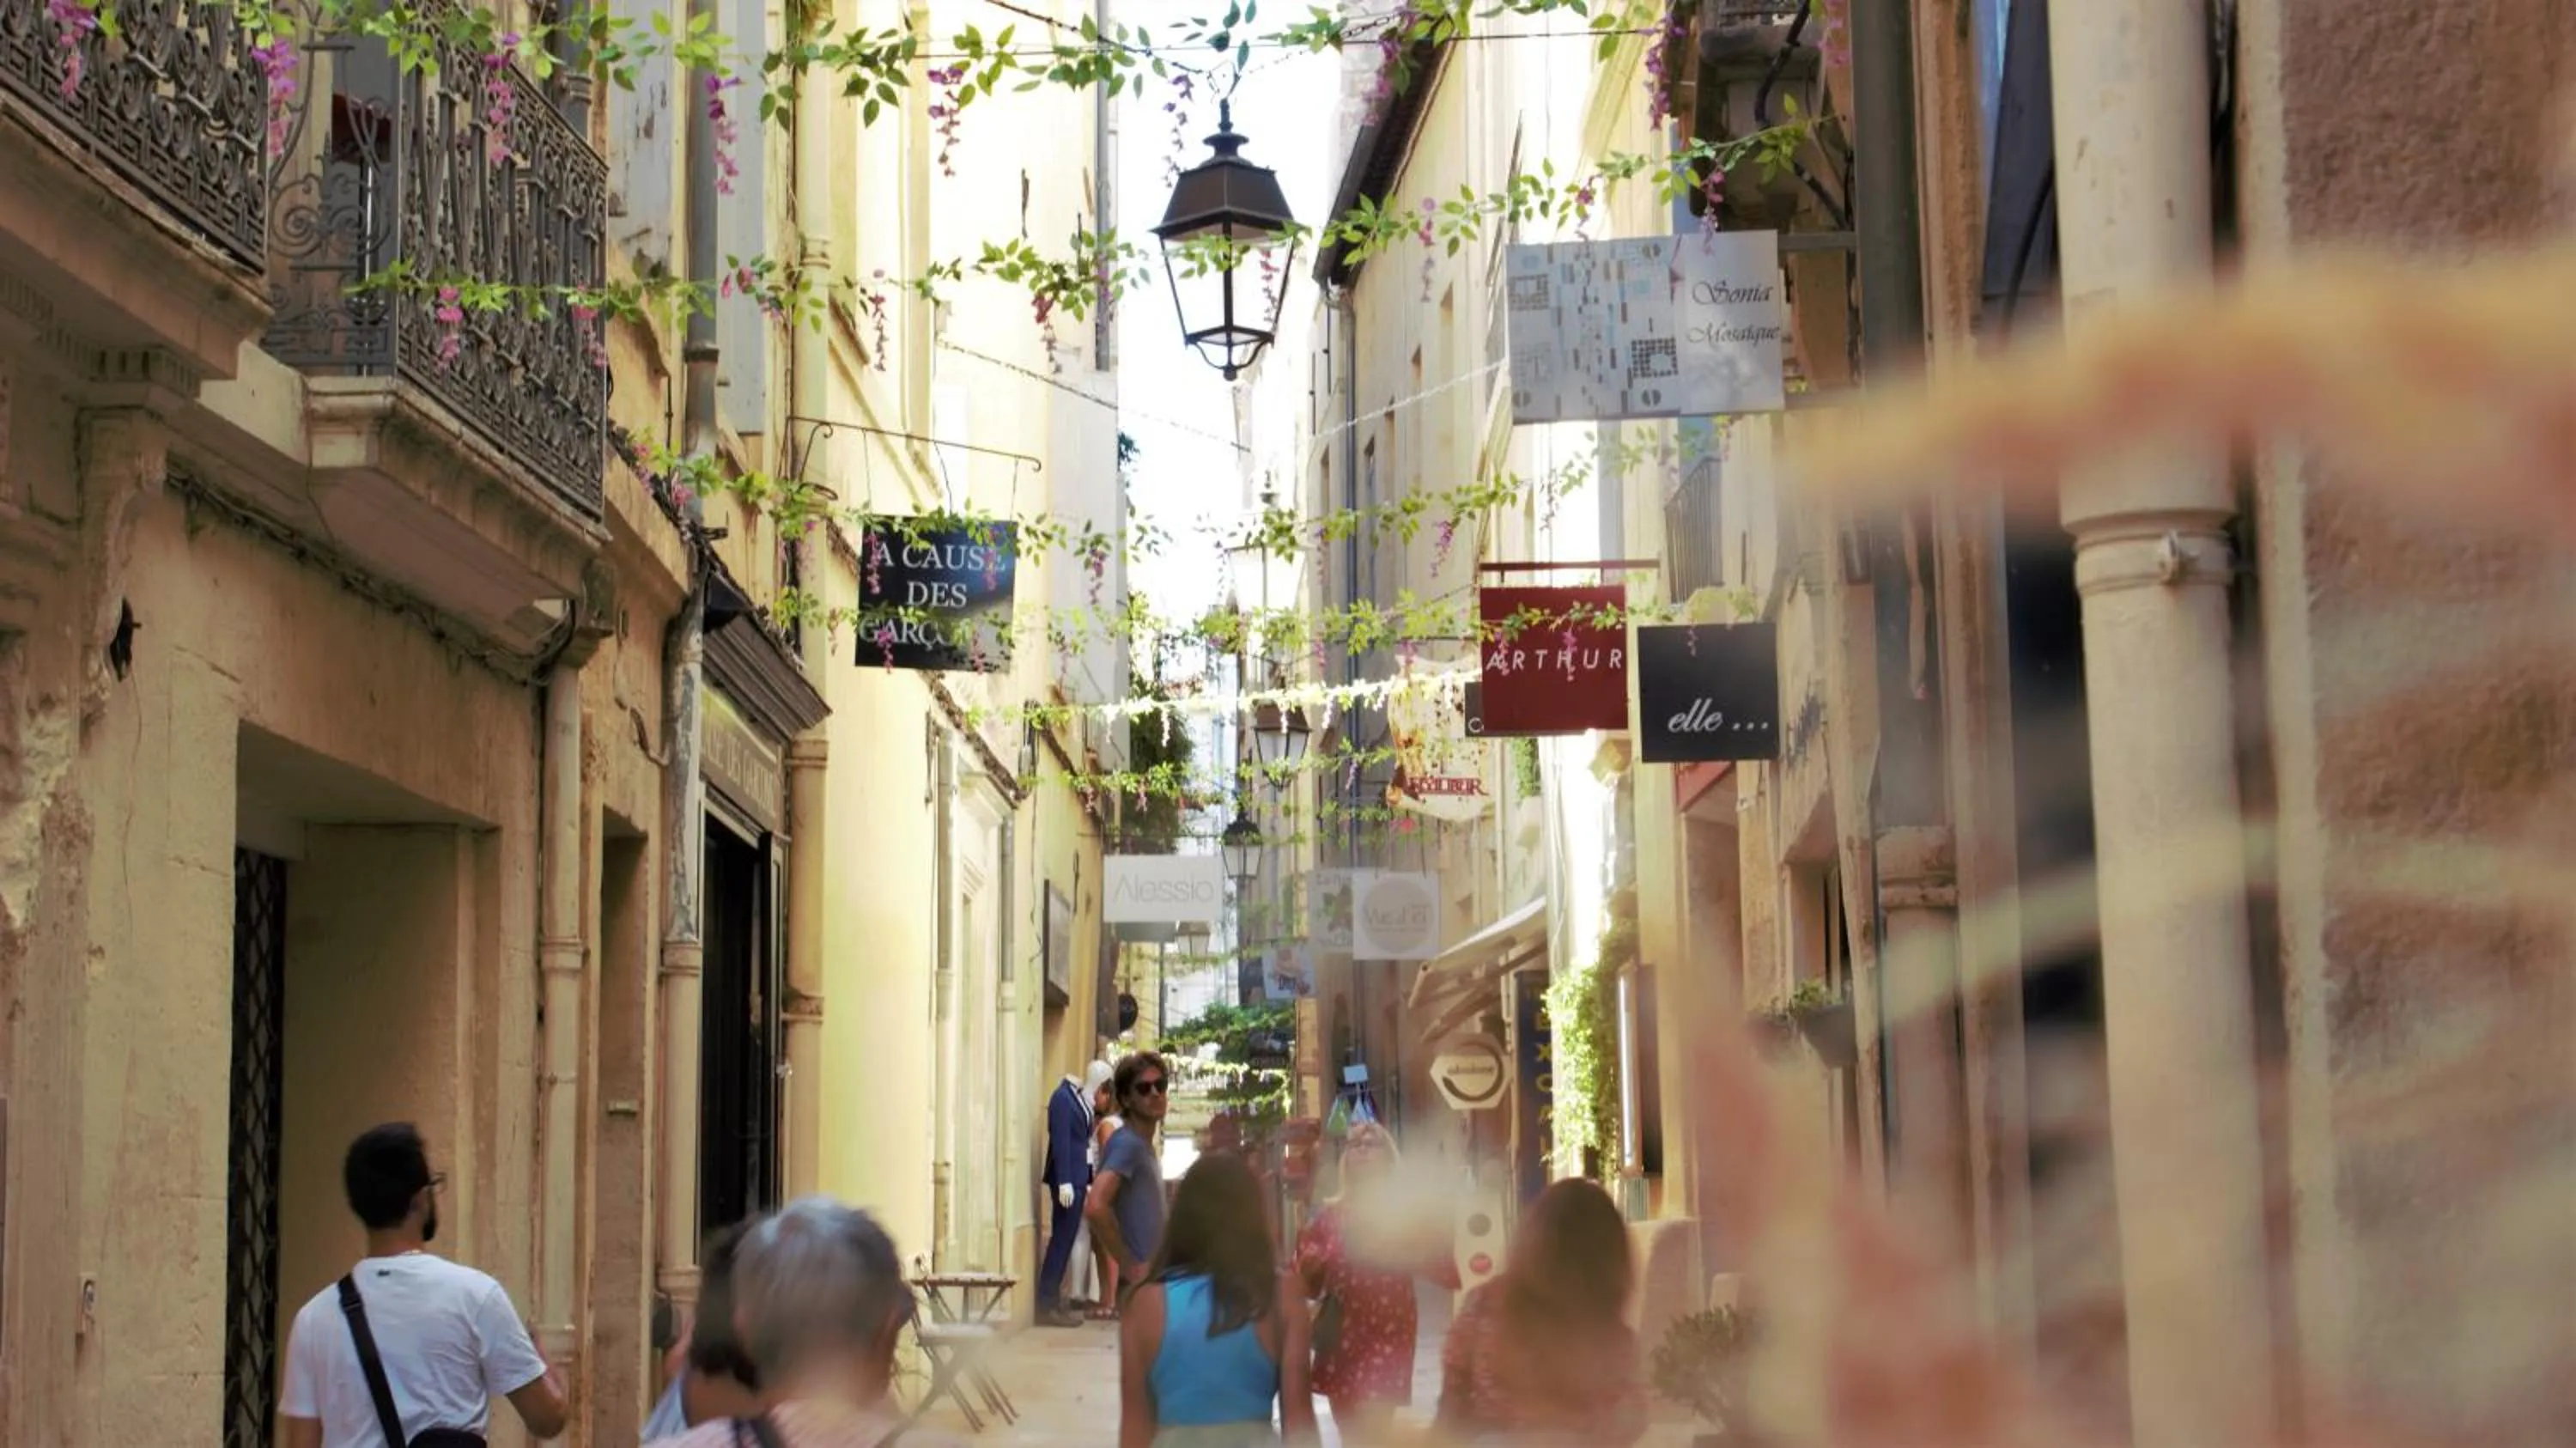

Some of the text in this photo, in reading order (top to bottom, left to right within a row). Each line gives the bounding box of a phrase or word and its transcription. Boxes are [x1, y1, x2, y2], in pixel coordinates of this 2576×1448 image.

[1692, 279, 1774, 305] Sonia
[872, 542, 894, 567] A
[906, 581, 968, 608] DES
[859, 617, 969, 652] GARÇ
[1485, 648, 1622, 672] ARTHUR
[1668, 697, 1723, 733] elle
[1114, 873, 1215, 903] Alessio
